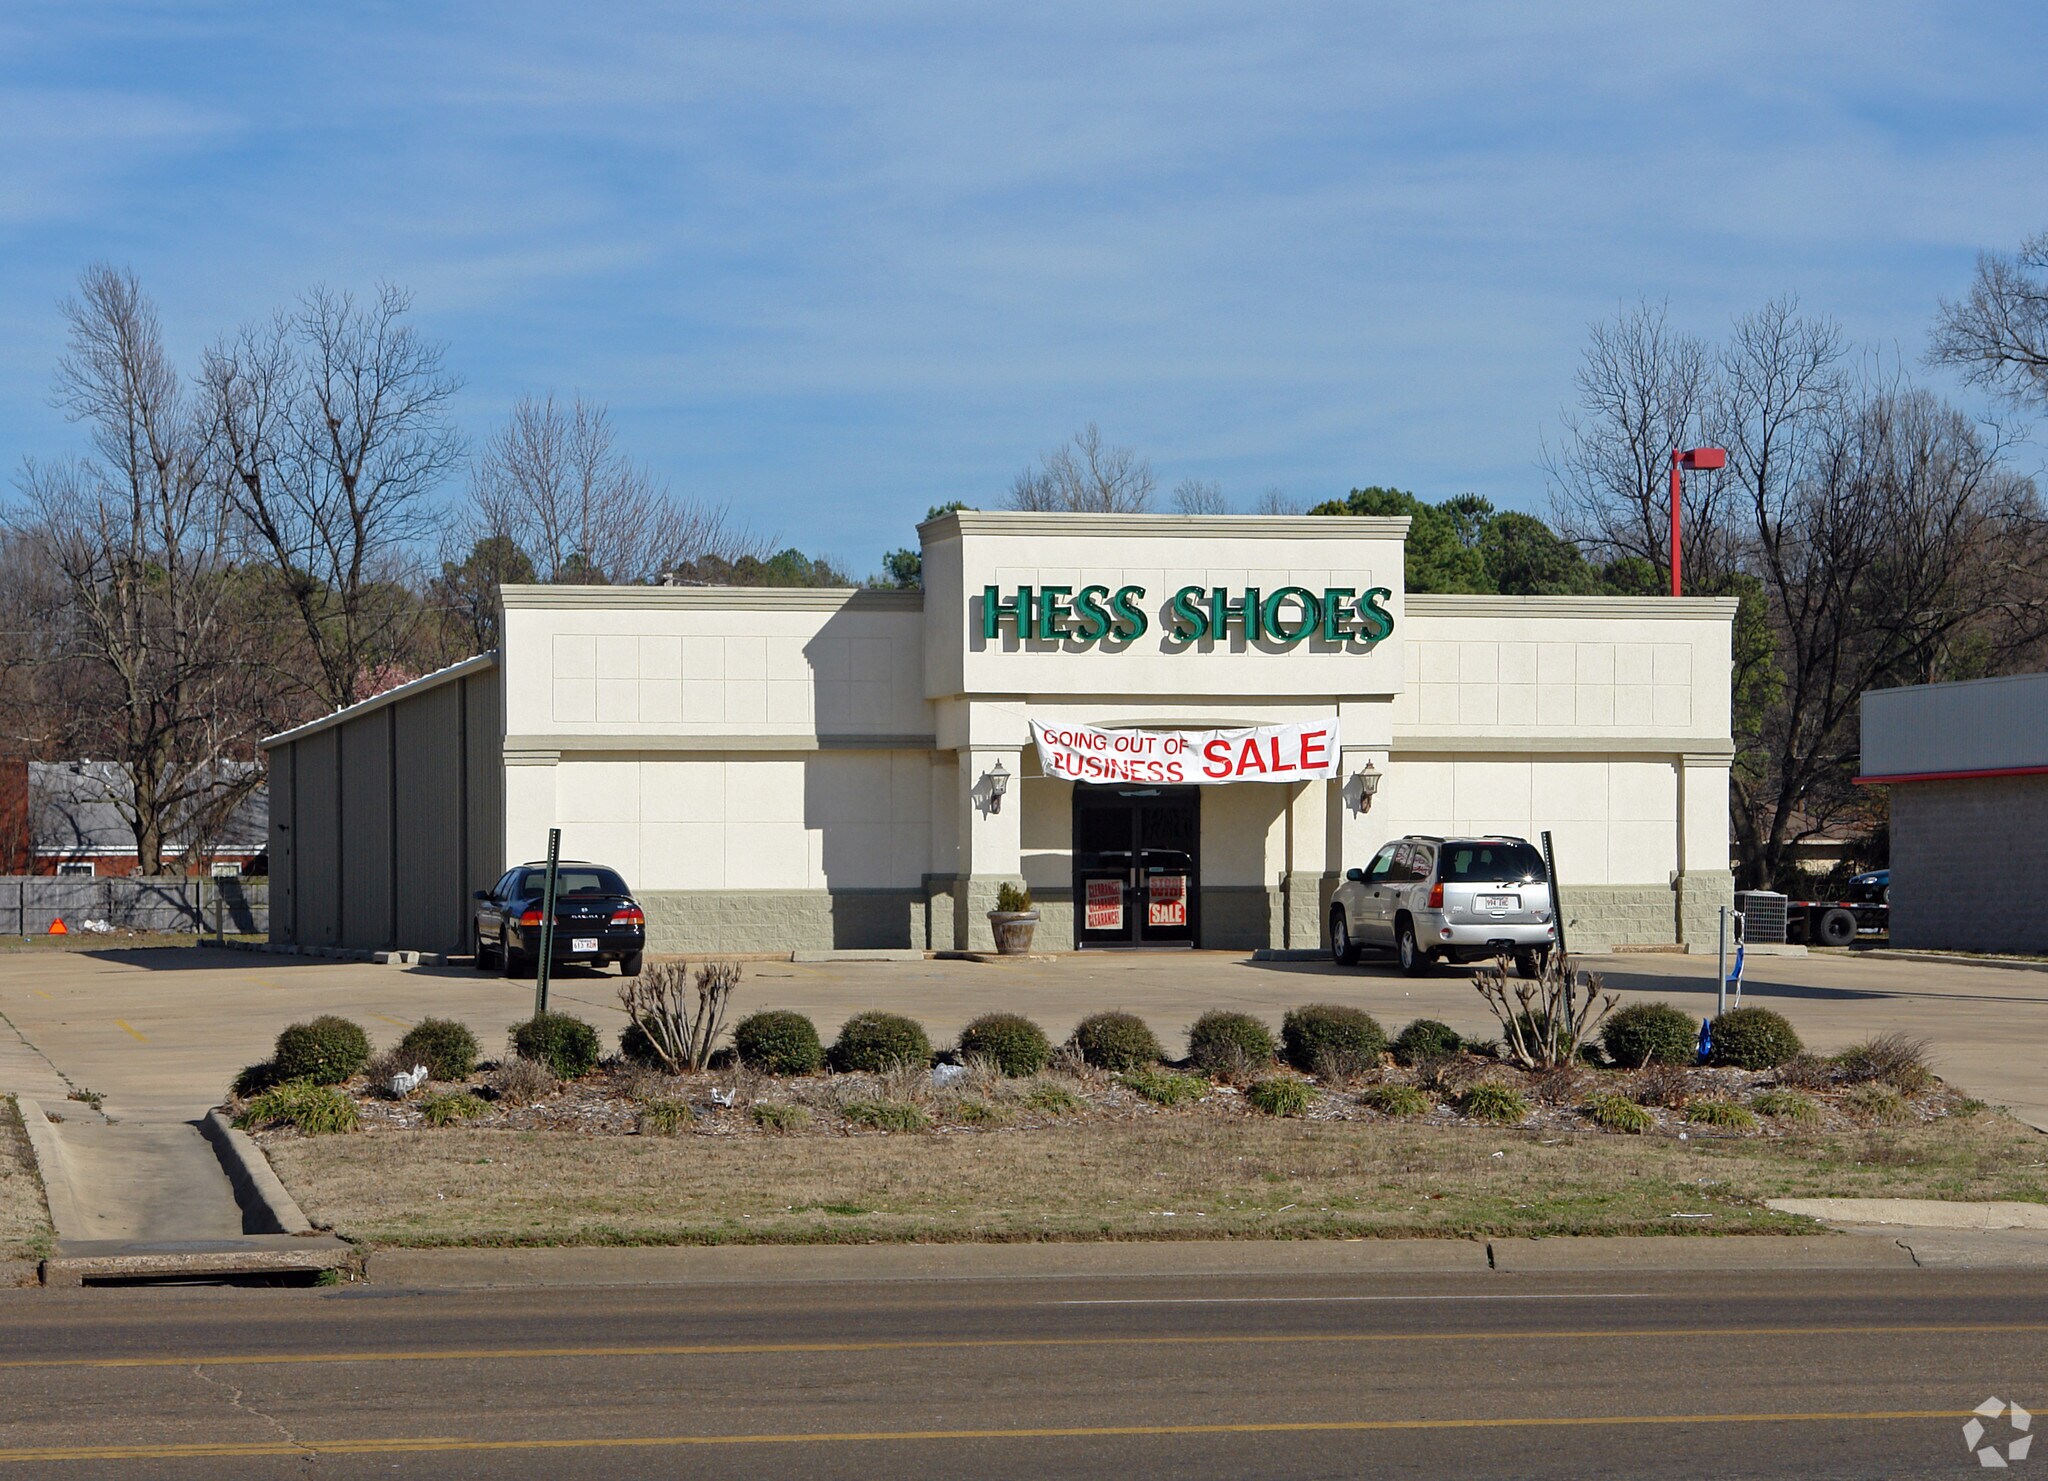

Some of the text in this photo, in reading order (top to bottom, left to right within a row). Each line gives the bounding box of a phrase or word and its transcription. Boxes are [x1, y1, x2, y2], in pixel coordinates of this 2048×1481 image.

[983, 585, 1395, 643] HESS SHOES
[1044, 729, 1189, 755] GOING OUT OF
[1203, 730, 1330, 778] SALE
[1151, 903, 1183, 923] SALE
